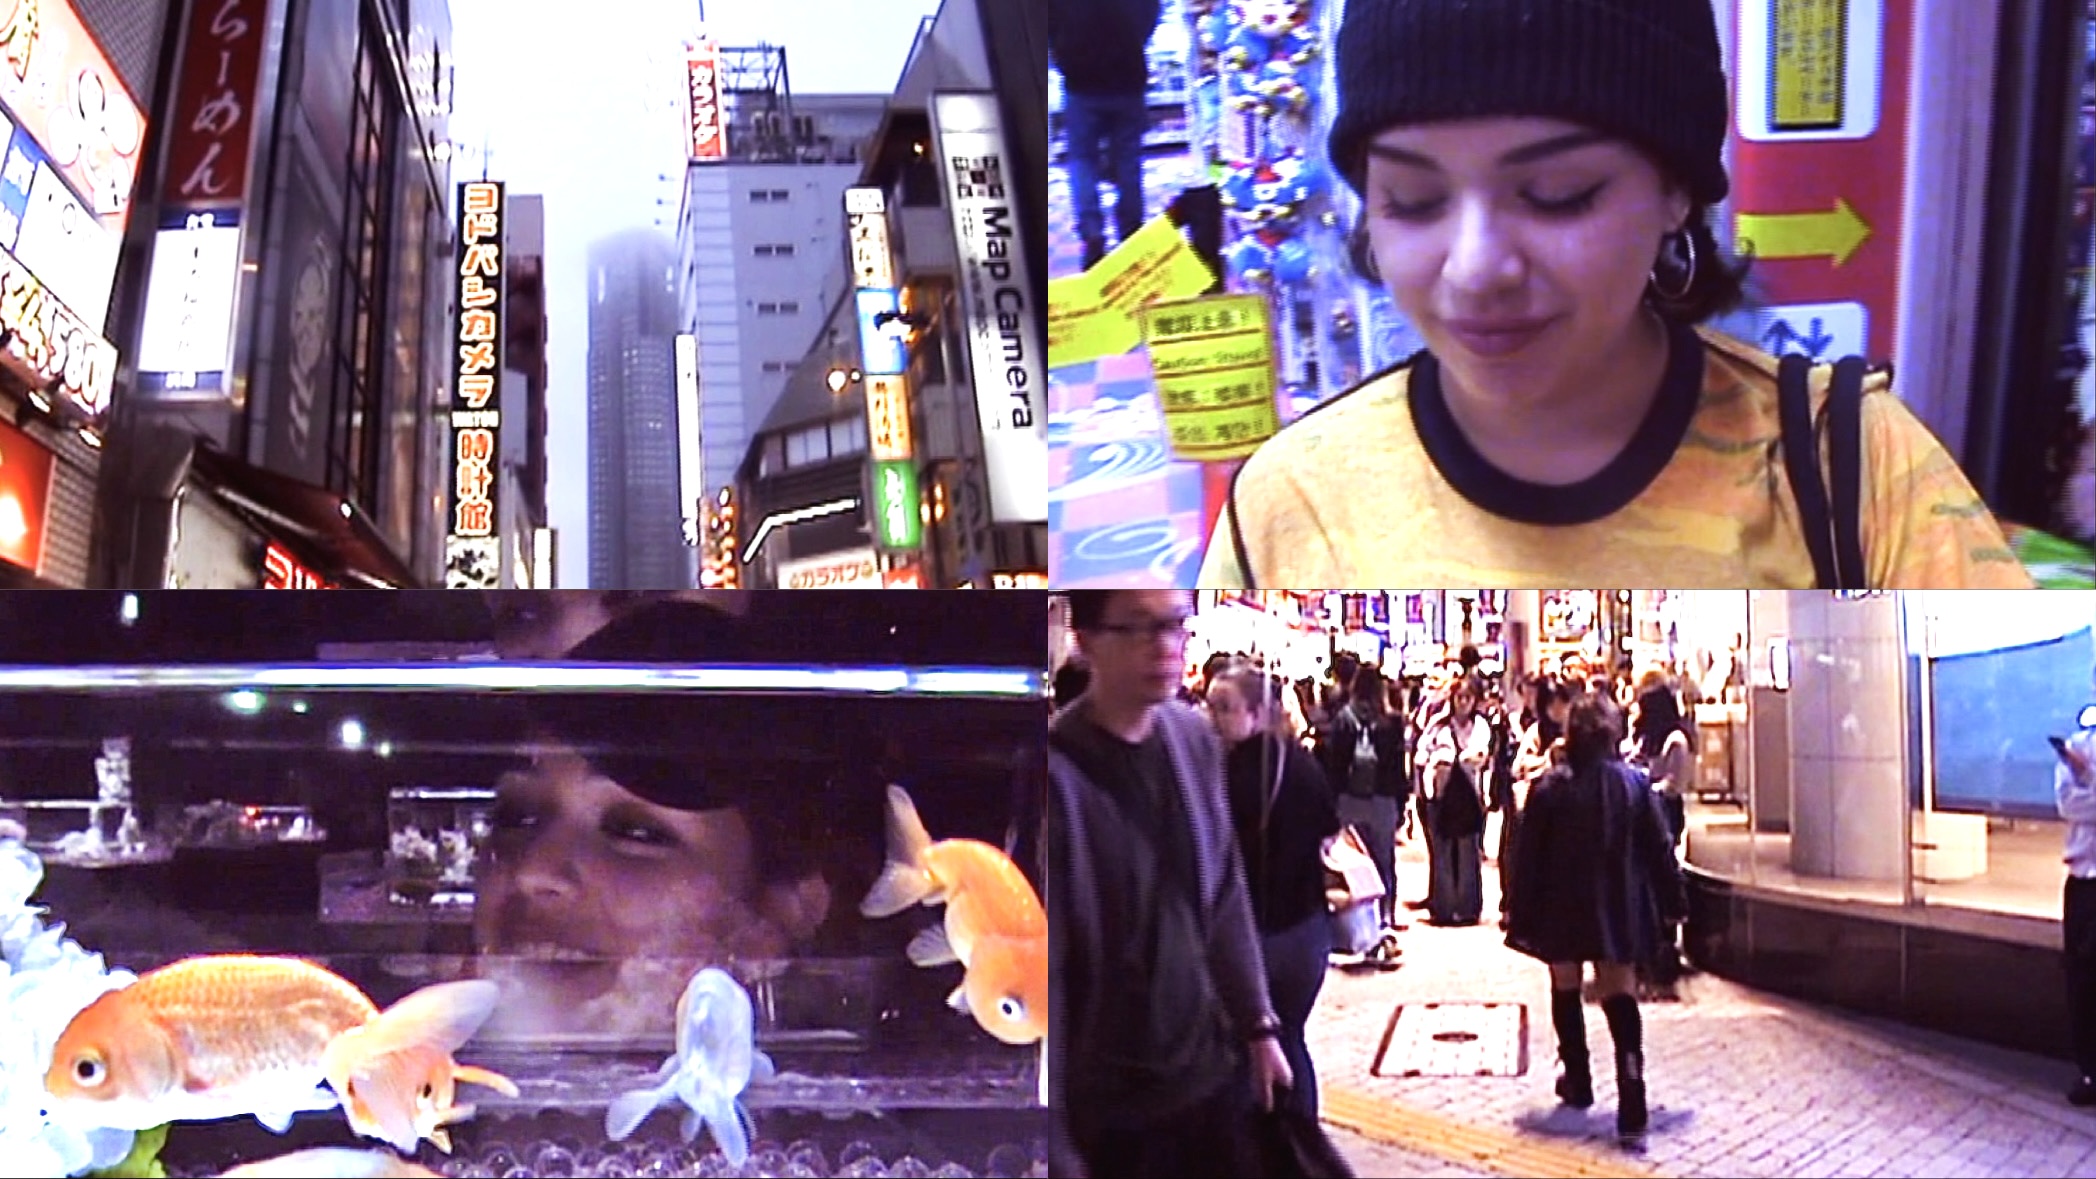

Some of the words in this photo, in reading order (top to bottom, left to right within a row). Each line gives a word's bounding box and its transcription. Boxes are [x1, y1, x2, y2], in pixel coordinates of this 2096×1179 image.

[180, 0, 248, 195] らーめん
[691, 65, 718, 145] カラオケ
[460, 183, 499, 408] ヨドバシカメラ
[981, 206, 1012, 281] Map
[994, 287, 1034, 430] Camera
[455, 429, 493, 536] 時計館
